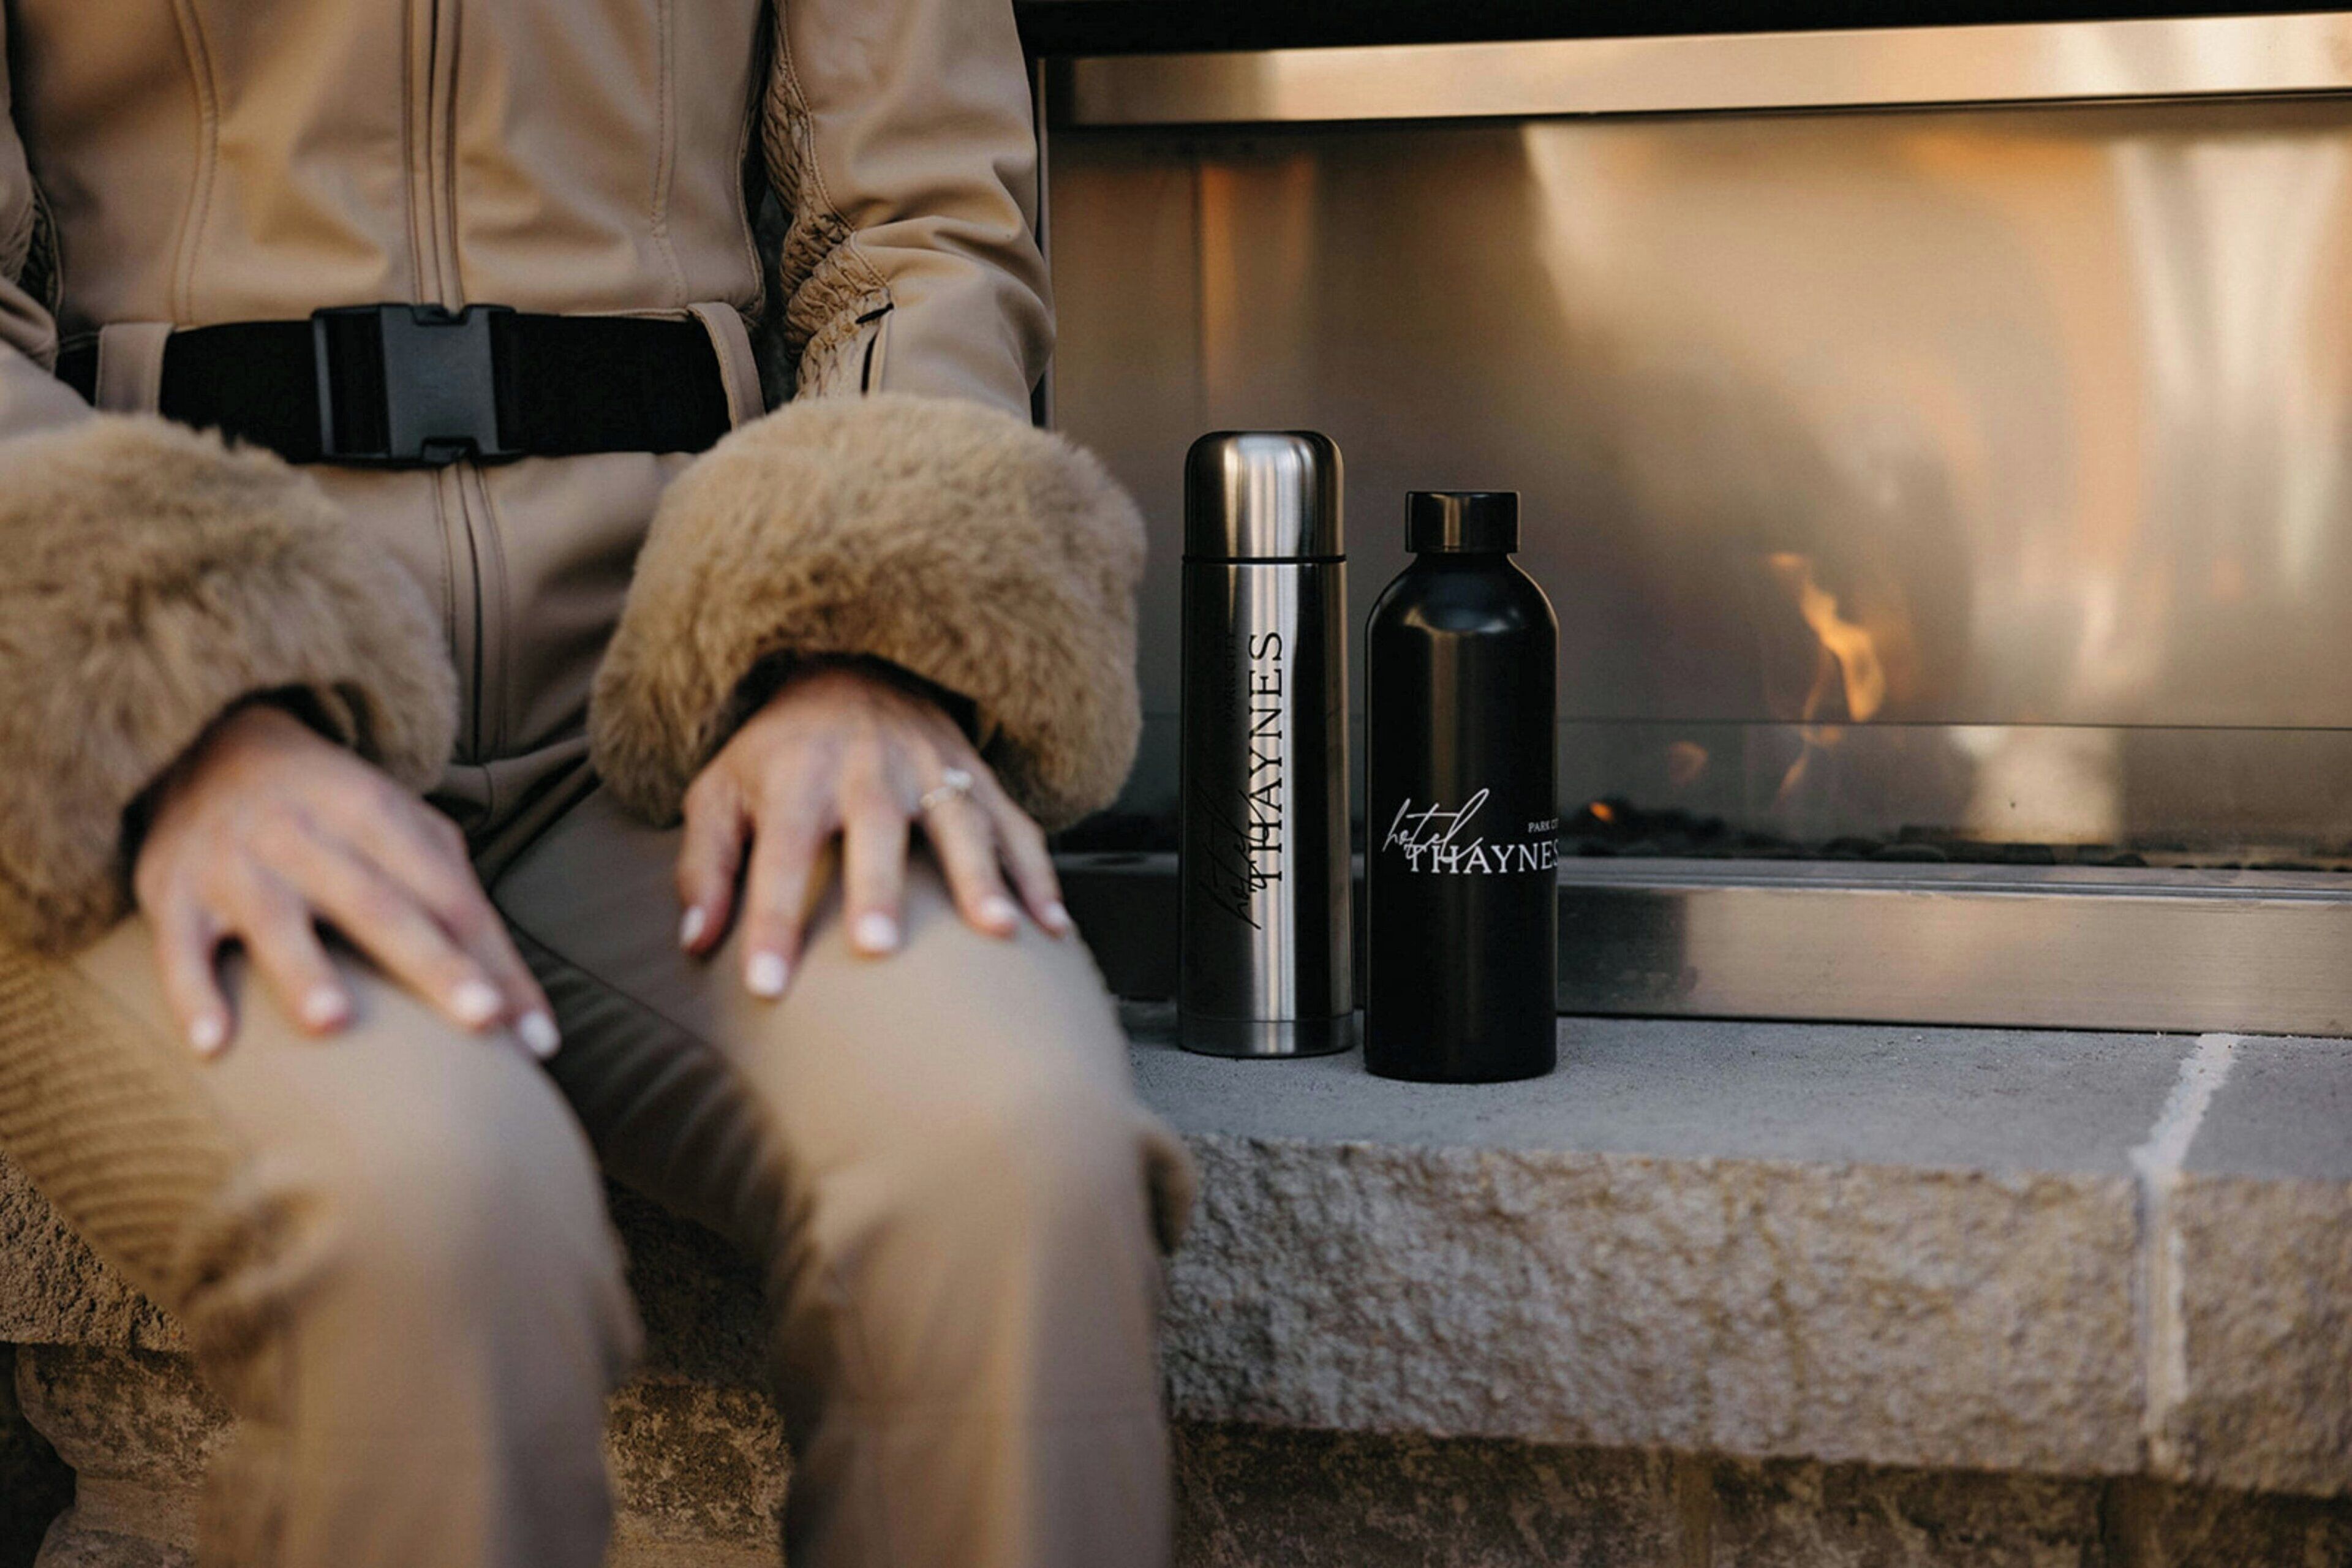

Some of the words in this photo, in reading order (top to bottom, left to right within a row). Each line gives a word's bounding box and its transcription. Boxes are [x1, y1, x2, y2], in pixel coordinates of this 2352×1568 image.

[1248, 631, 1283, 892] THAYNES
[1382, 788, 1490, 864] hotel
[1191, 775, 1270, 930] hotel
